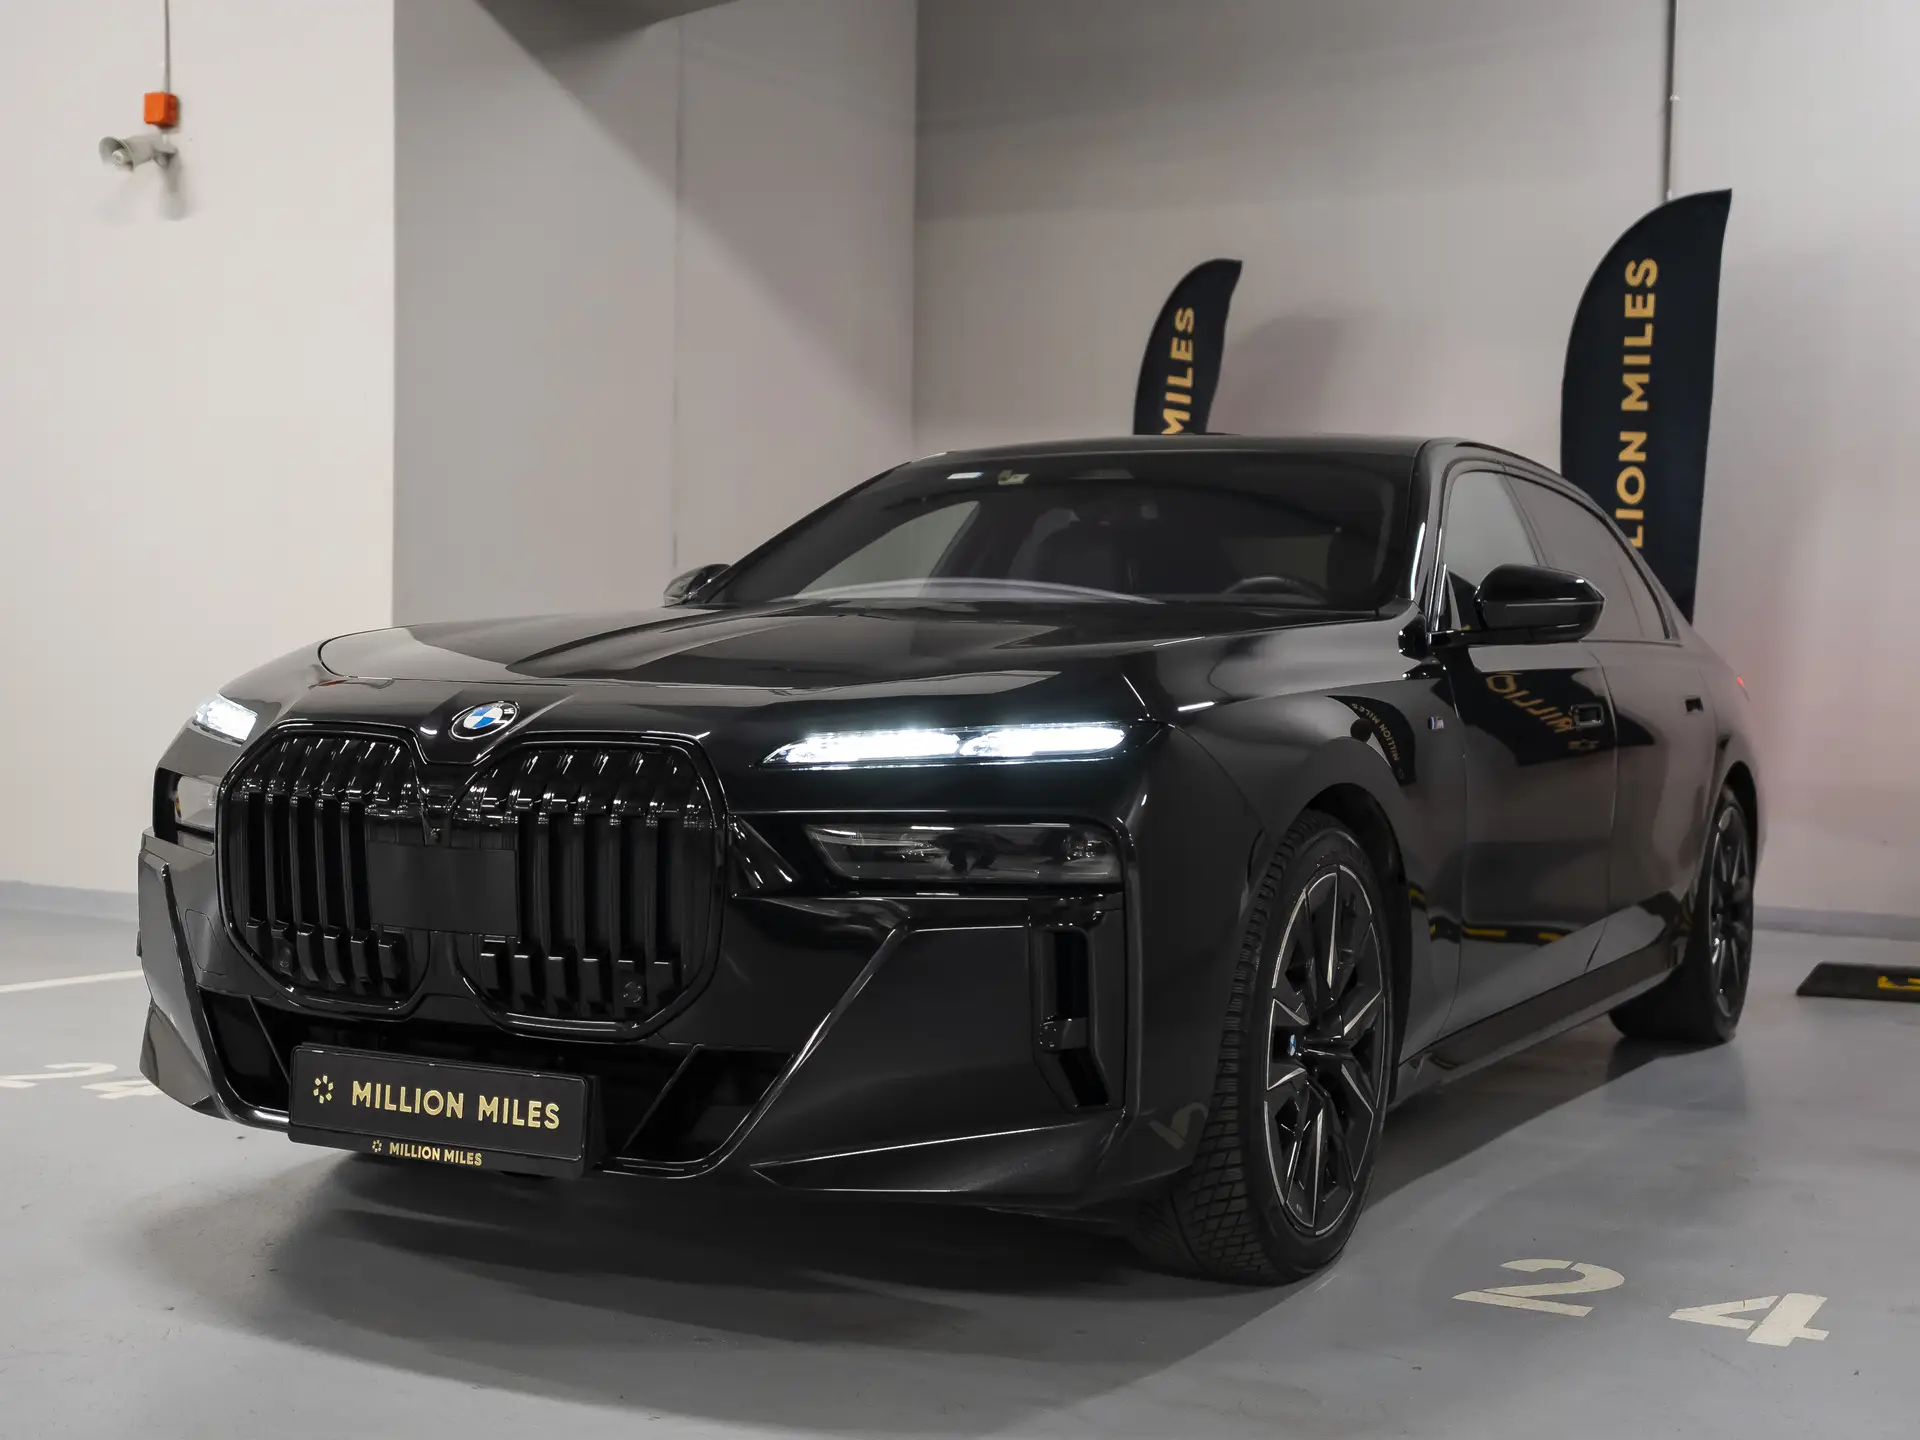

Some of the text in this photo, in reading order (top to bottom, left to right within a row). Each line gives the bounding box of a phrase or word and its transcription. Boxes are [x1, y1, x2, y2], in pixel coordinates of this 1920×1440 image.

[1161, 306, 1195, 435] MILES
[1621, 257, 1659, 412] MILES
[352, 1080, 560, 1130] MILLION MILES
[389, 1142, 483, 1167] MILLION MILES
